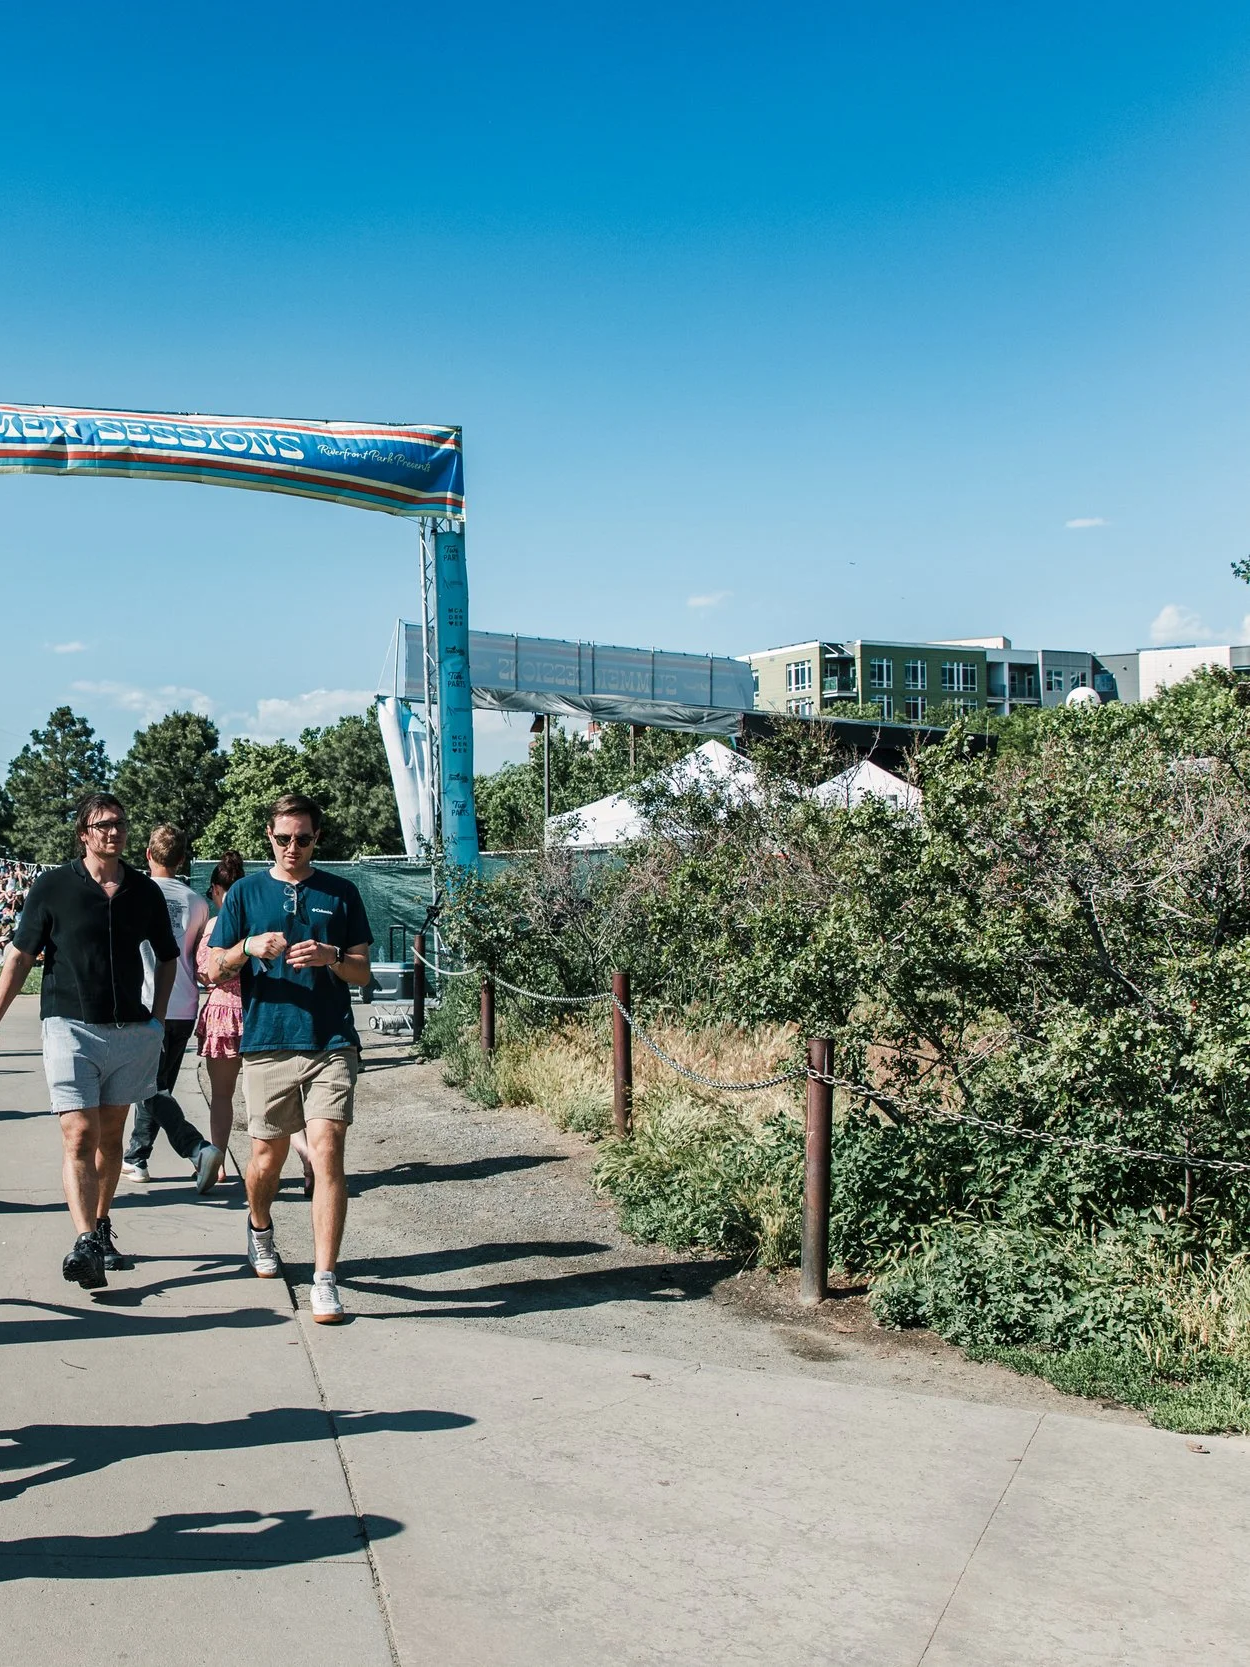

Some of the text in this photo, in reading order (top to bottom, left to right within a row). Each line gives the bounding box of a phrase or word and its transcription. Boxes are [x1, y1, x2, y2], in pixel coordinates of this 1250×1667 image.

[94, 420, 305, 460] SESSIONS
[317, 444, 431, 472] Riverfront Park Presents
[451, 809, 470, 817] PARTS
